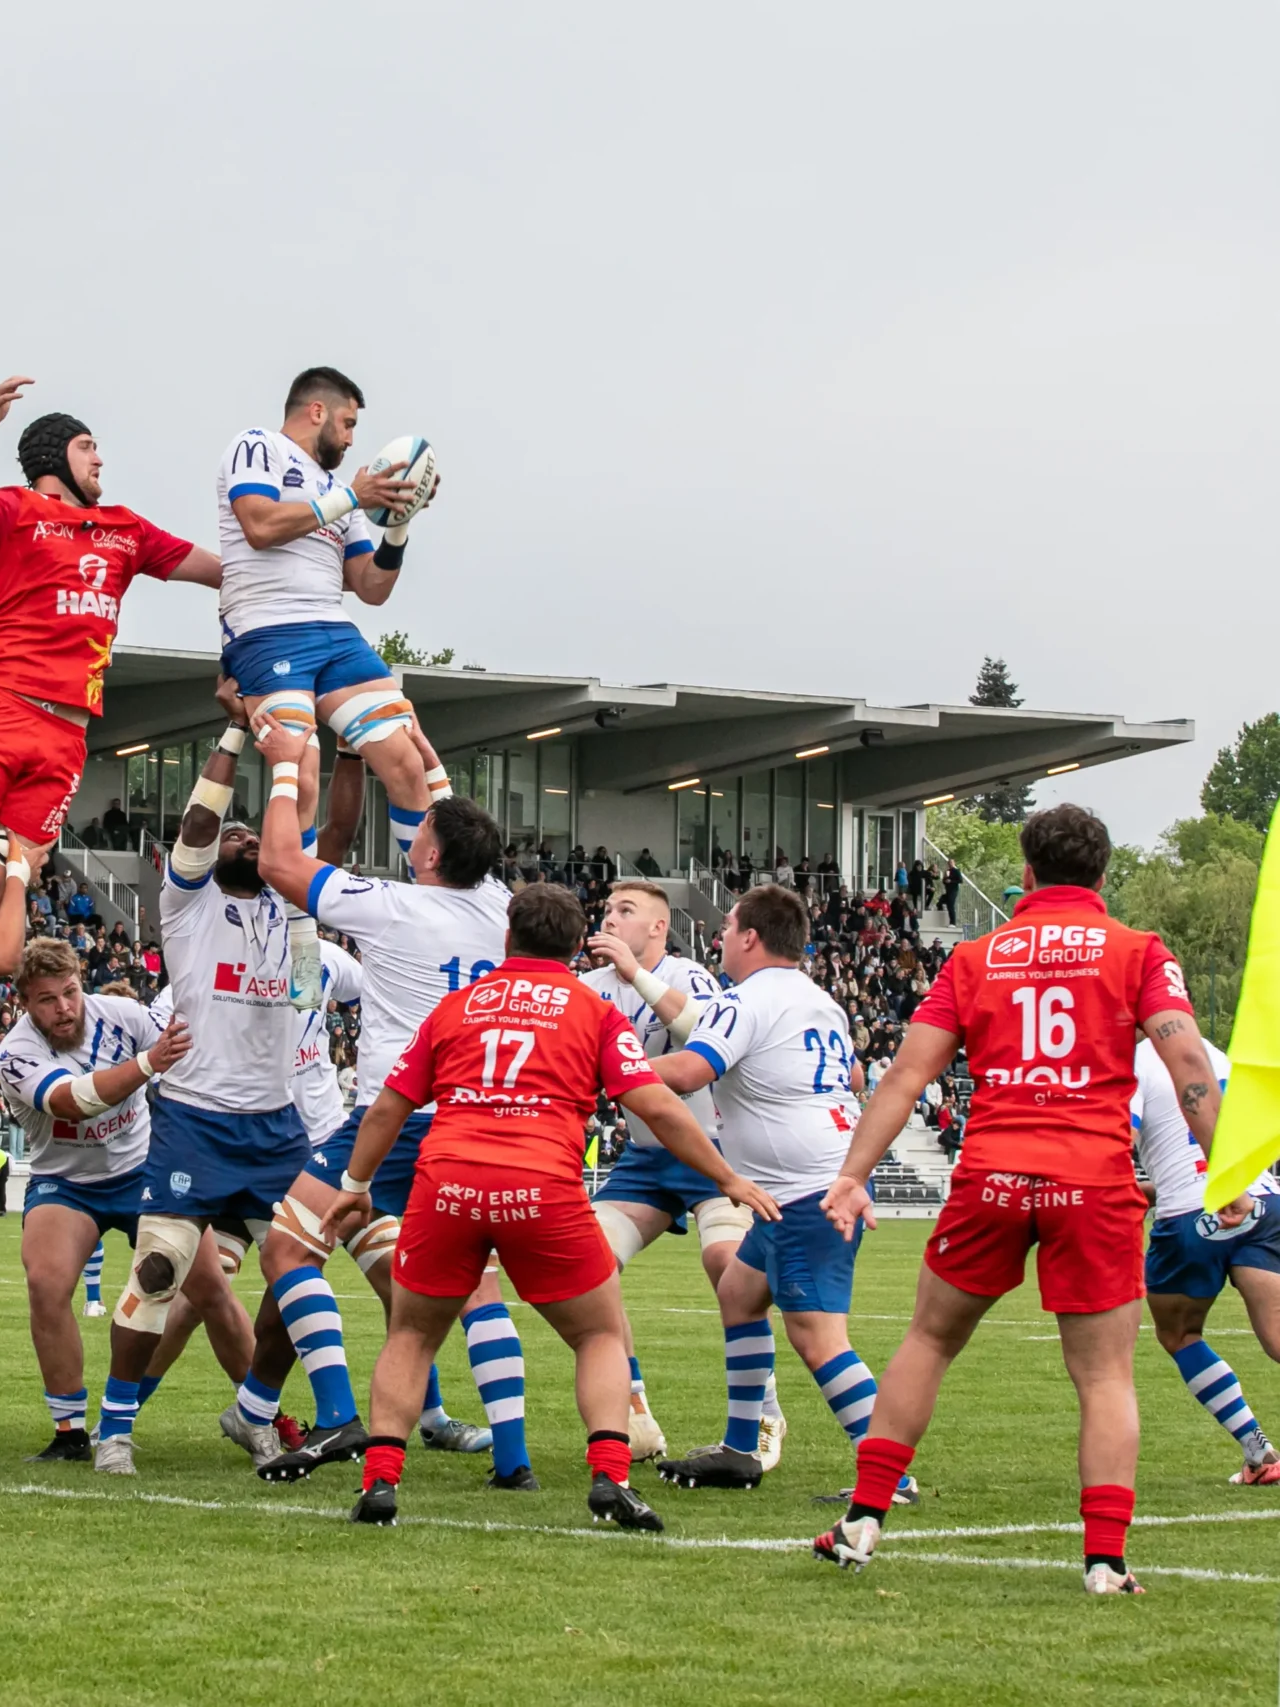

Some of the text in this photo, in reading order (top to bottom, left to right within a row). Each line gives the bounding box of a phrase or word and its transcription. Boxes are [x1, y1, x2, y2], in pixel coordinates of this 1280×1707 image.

[32, 520, 75, 541] AGON
[1039, 925, 1107, 949] PGS
[1038, 947, 1104, 964] GROUP
[986, 968, 1100, 981] CARRIES YOUR BUSINESS
[510, 980, 571, 1006] PGS
[508, 998, 565, 1017] GROUP
[498, 1015, 520, 1025] YOUR
[1011, 986, 1076, 1061] 16
[480, 1028, 536, 1089] 17
[83, 1105, 138, 1140] AGEMA
[463, 1187, 542, 1206] PIERRE
[981, 1187, 1084, 1211] DE SEINE
[435, 1198, 541, 1223] DE SEINE
